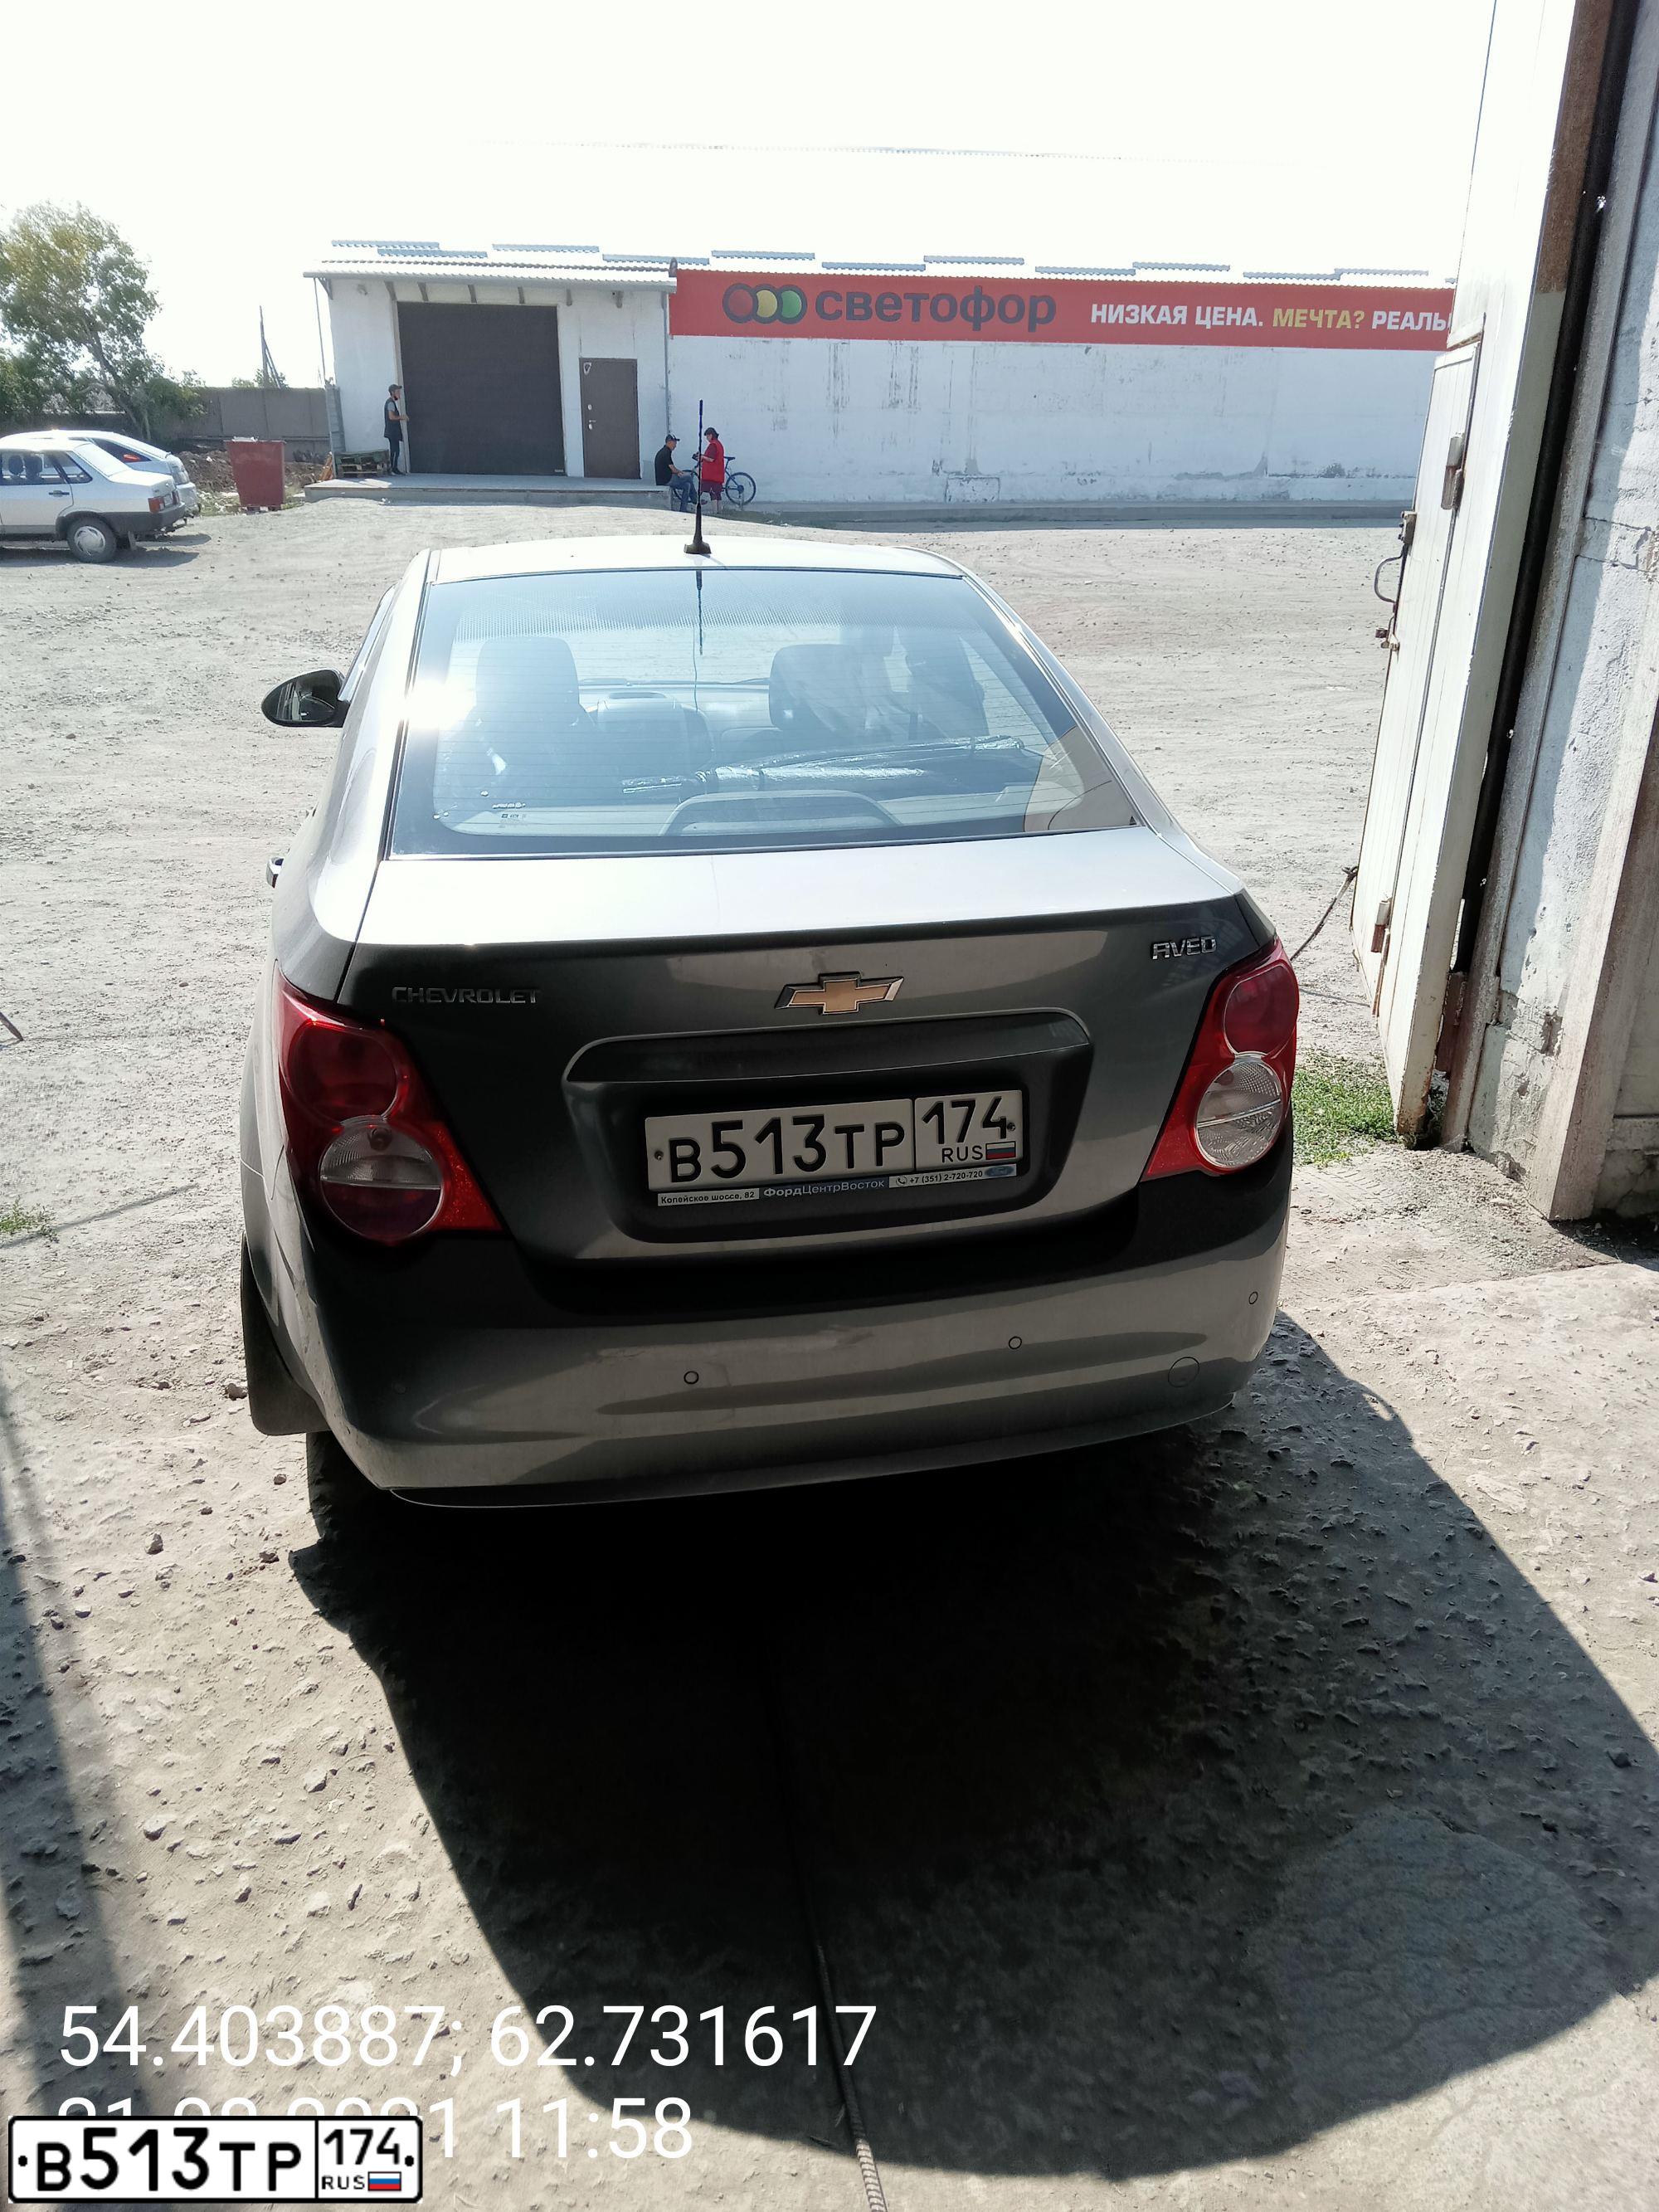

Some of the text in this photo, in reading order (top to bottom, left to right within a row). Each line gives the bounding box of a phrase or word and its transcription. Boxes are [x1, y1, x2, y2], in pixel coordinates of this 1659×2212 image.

[815, 285, 1057, 333] светофор
[1090, 304, 1452, 331] НИЗКАЯ ЦЕНА. МЕЧТА? РЕАЛЬ
[1151, 935, 1217, 960] AVEO
[391, 986, 539, 1004] CHEVROLET
[921, 1095, 1008, 1145] 174
[941, 1145, 984, 1162] RUS
[922, 1173, 942, 1184] (351)
[944, 1170, 983, 1182] 2-720-720
[763, 1180, 885, 1198] ФордЦентрВосток
[660, 1195, 709, 1205] Копейское
